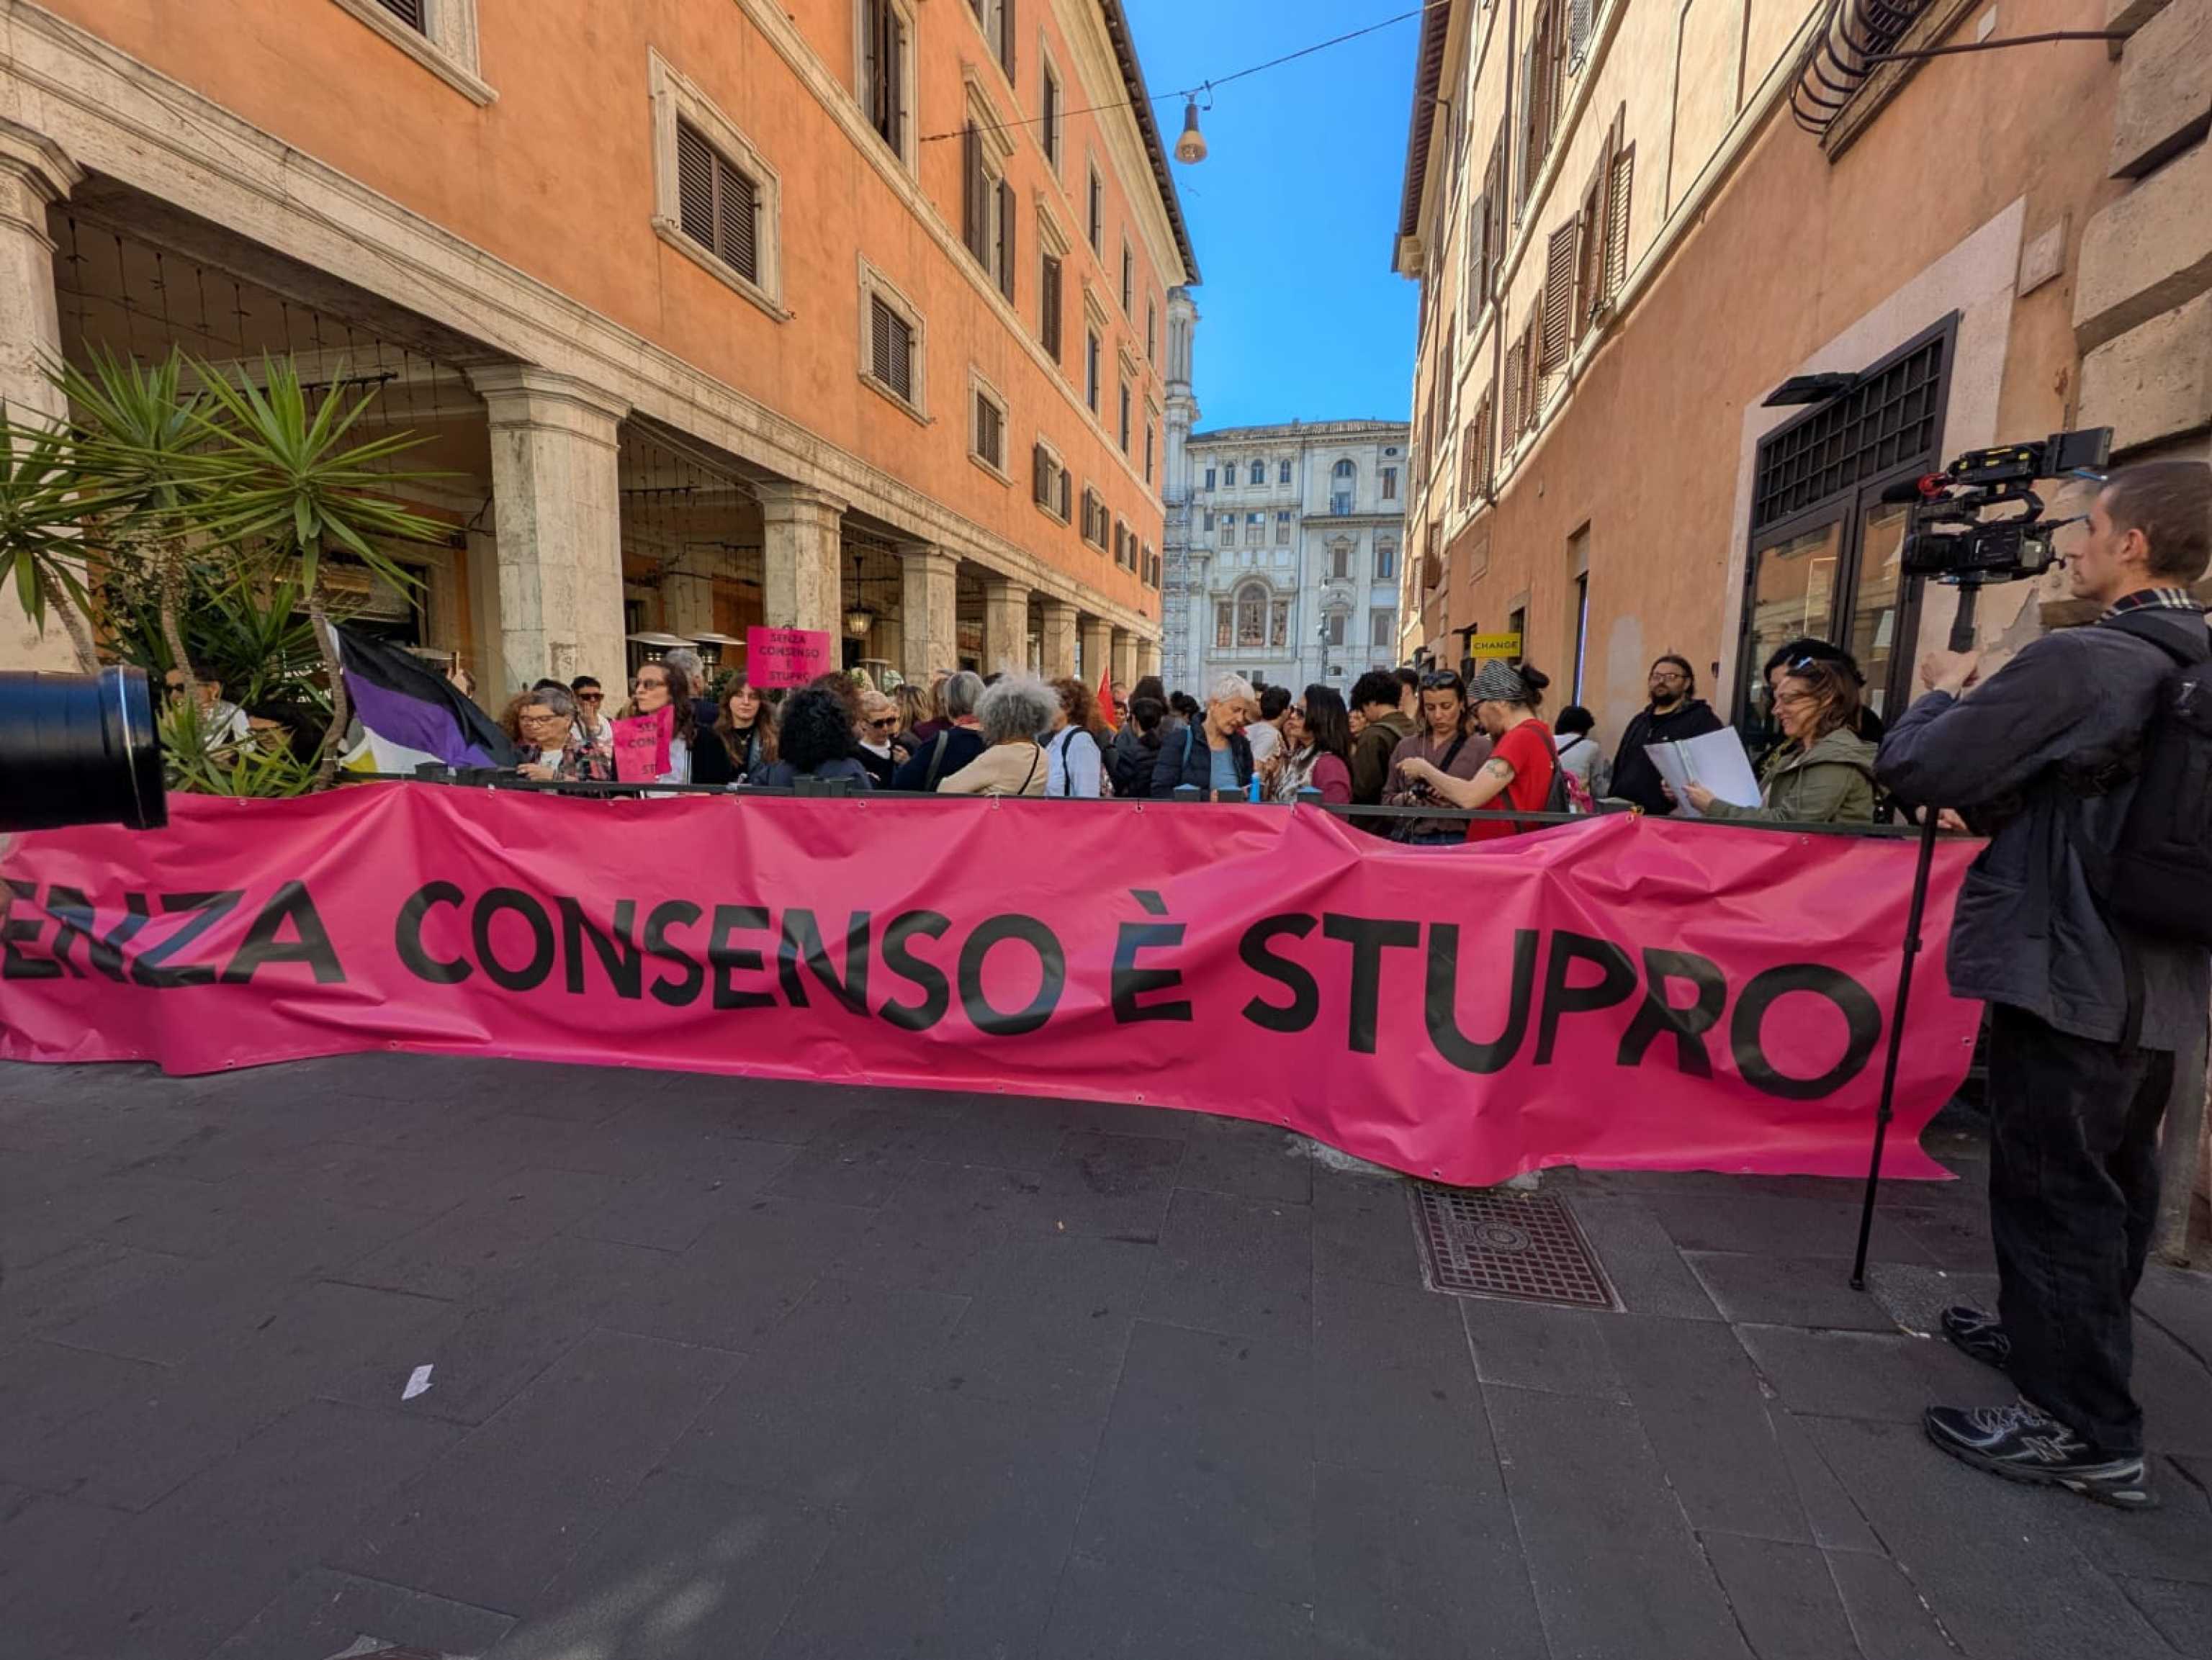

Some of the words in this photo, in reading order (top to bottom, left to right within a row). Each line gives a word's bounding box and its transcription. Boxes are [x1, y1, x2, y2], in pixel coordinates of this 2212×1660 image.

[1474, 640, 1519, 649] CHANGE
[760, 646, 819, 658] CONSENSO
[395, 880, 1066, 1037] CONSENSO
[1110, 889, 1192, 1024] È
[1238, 912, 1883, 1101] STUPRO
